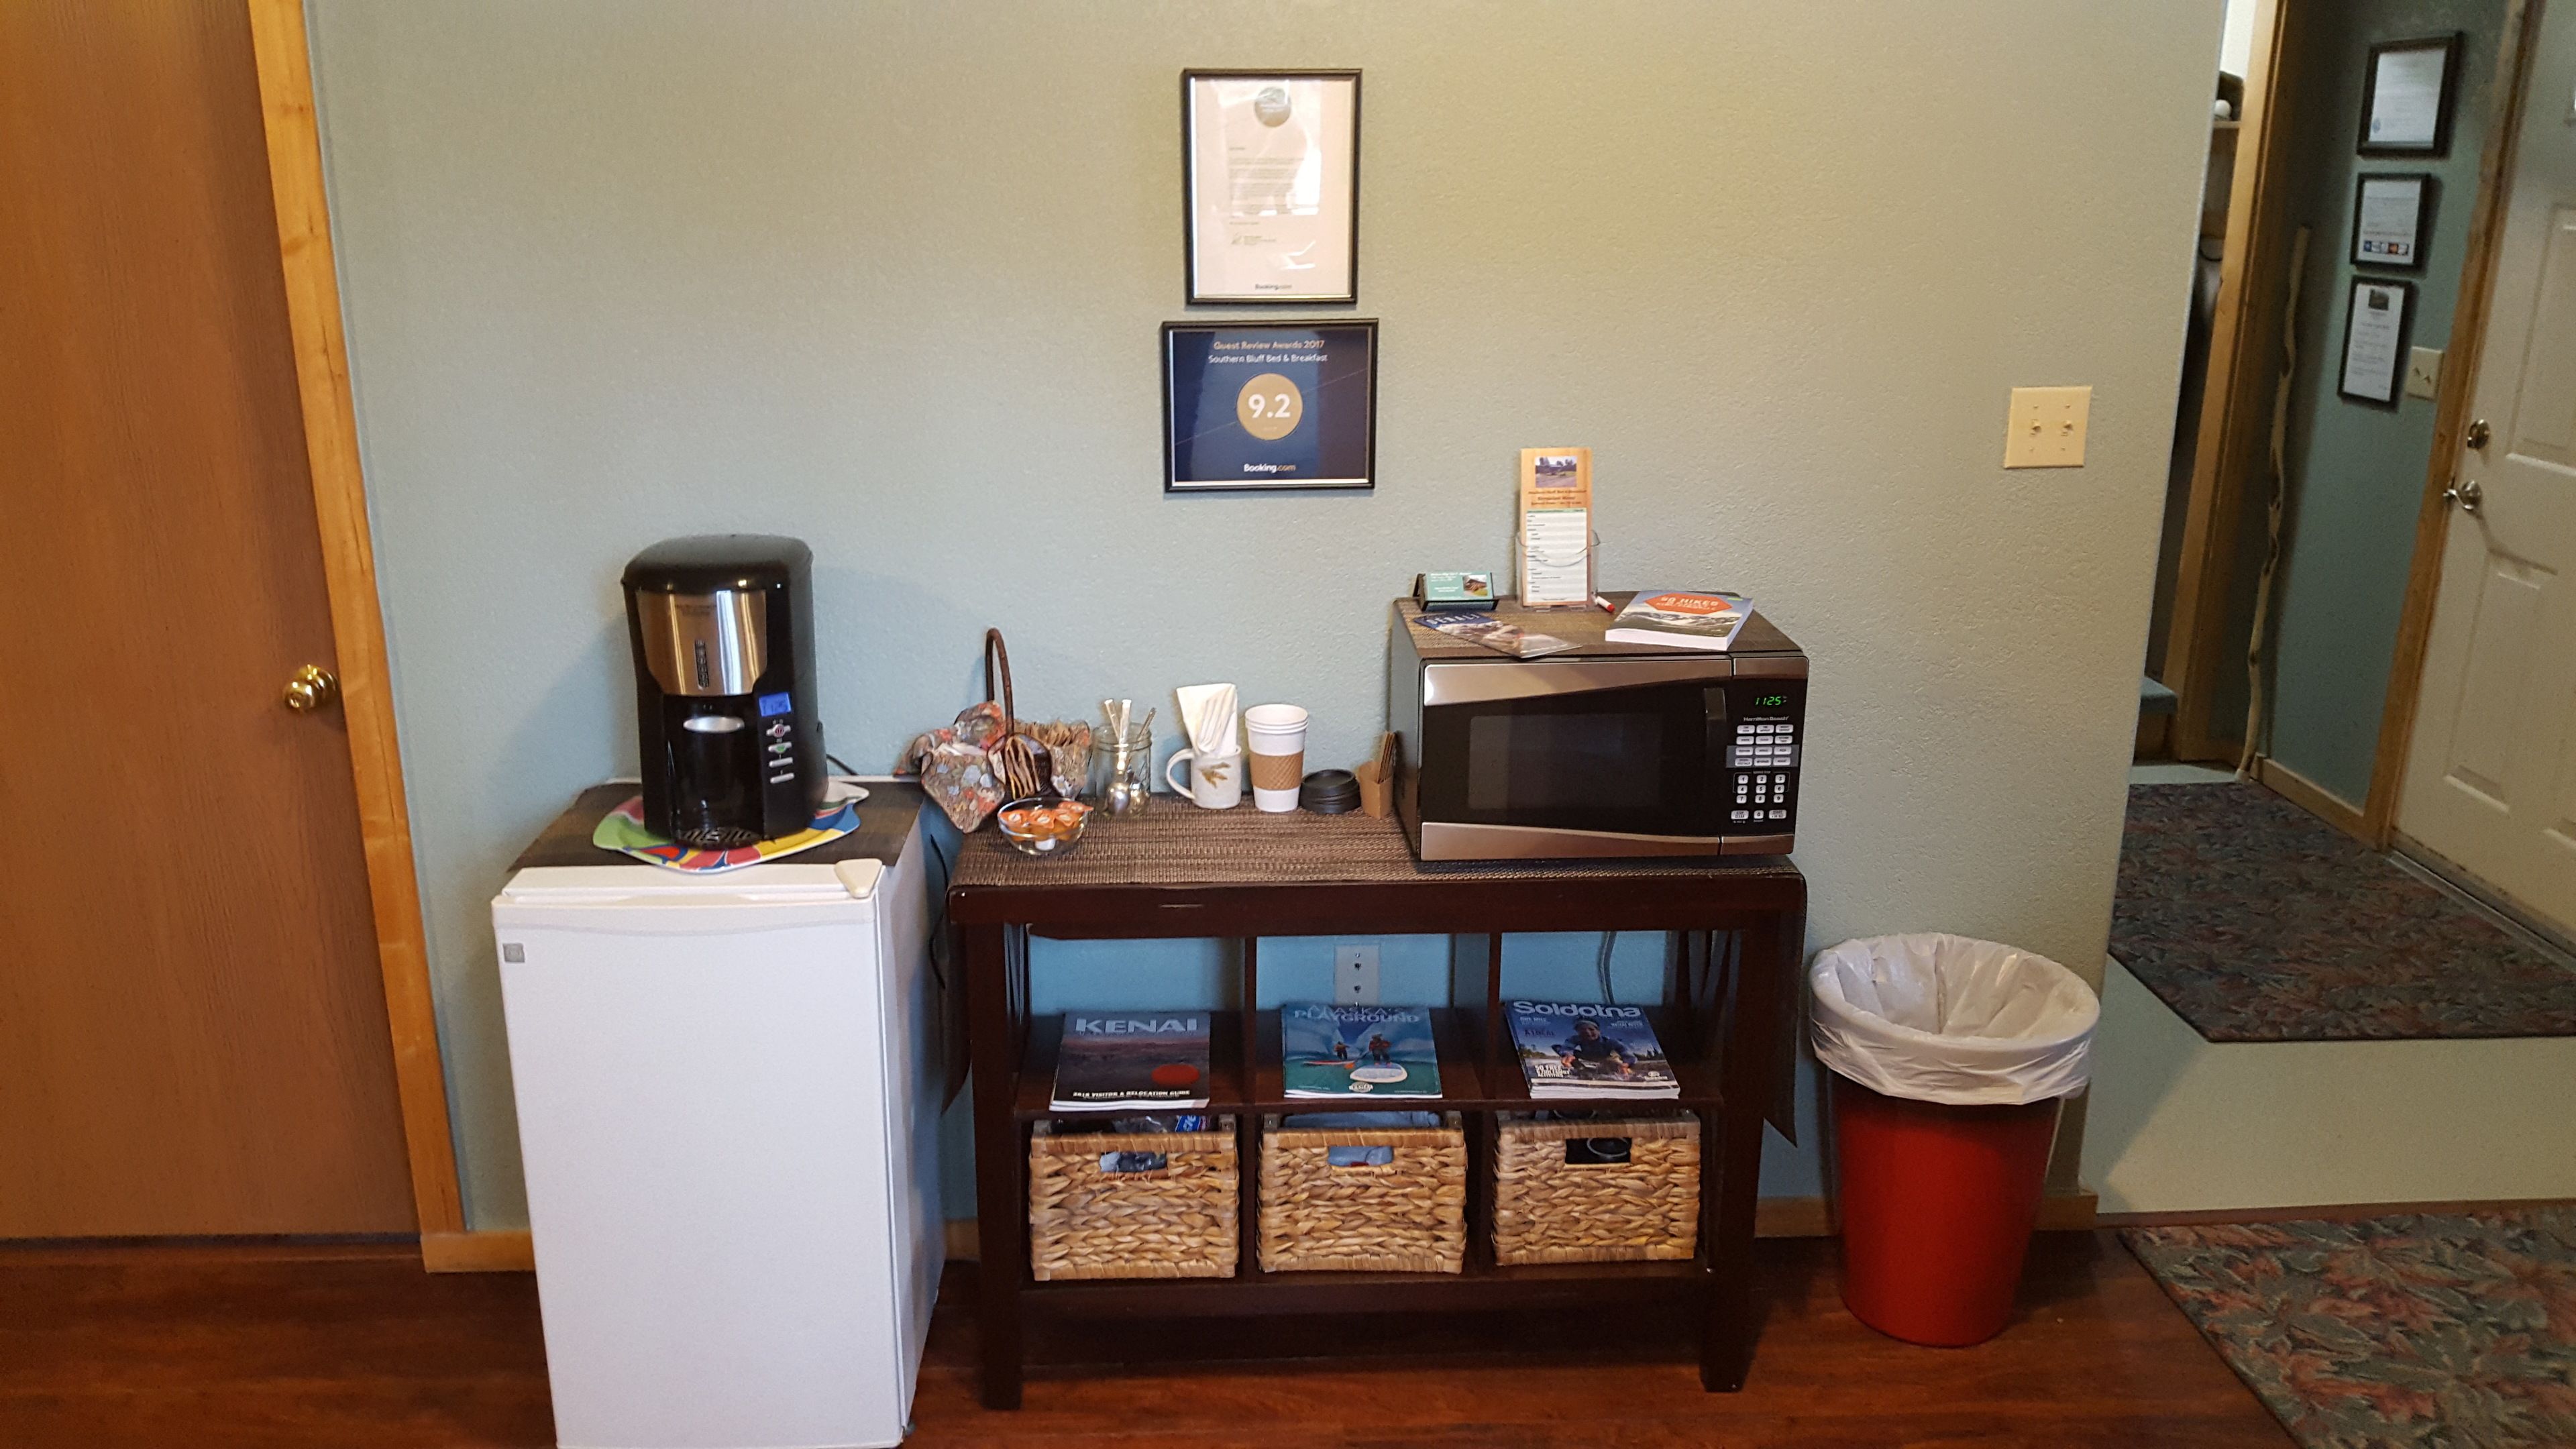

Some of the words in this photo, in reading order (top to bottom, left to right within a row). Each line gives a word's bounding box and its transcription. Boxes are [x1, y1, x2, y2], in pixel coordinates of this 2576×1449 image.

[1214, 341, 1240, 350] Guest
[1241, 341, 1270, 350] Review
[1273, 340, 1303, 349] Awards
[1303, 339, 1326, 349] 2017
[1208, 354, 1244, 364] Southern
[1246, 354, 1265, 363] Bluff
[1266, 354, 1281, 363] Bed
[1283, 354, 1289, 363] &
[1291, 354, 1328, 363] Breakfast
[1248, 393, 1291, 419] 9.2
[1243, 463, 1296, 474] Booking.com
[1295, 1008, 1420, 1023] PLAYGROUND
[1513, 1001, 1641, 1017] Soldotna
[1075, 1018, 1197, 1034] KENAI
